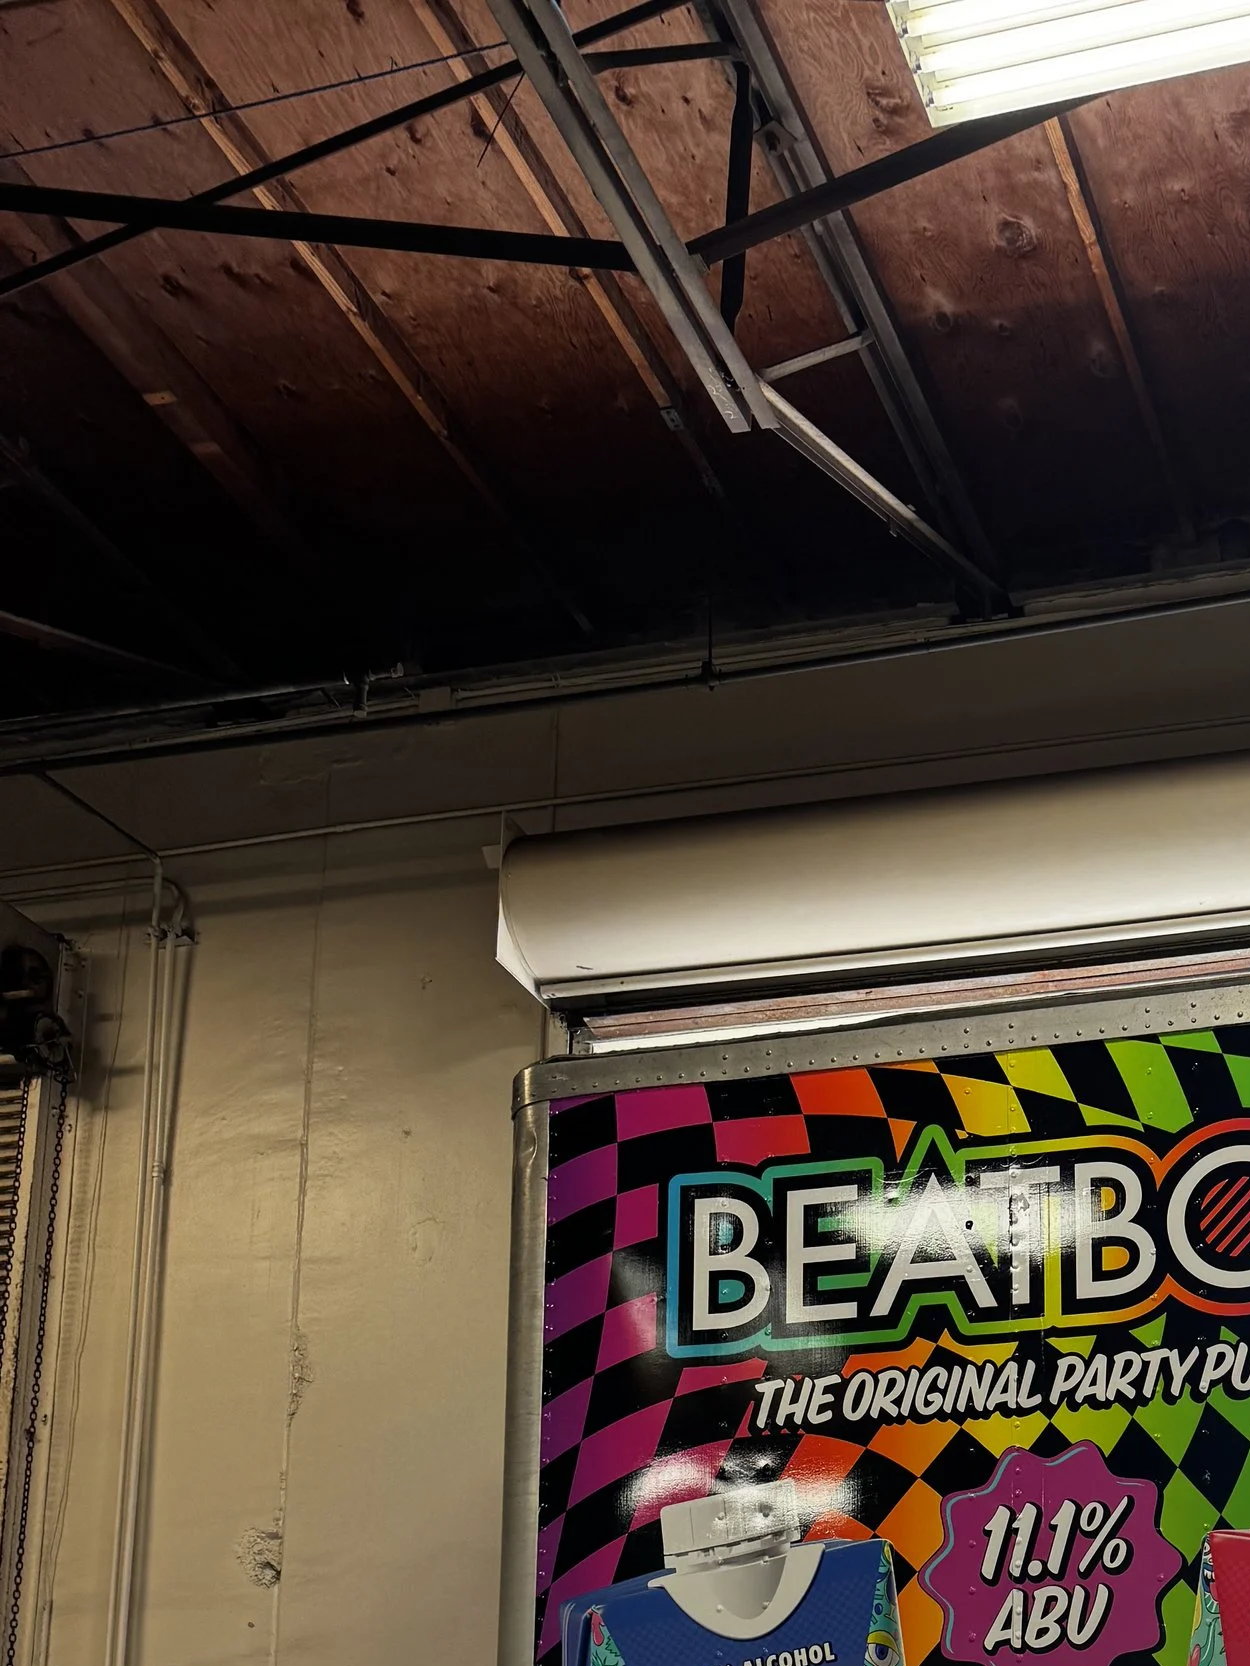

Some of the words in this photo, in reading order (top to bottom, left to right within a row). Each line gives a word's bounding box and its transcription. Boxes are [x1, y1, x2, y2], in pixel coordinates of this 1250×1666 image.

[755, 1375, 841, 1429] THE
[843, 1358, 1042, 1421] ORIGINAL
[1049, 1346, 1199, 1405] PARTY
[981, 1496, 1129, 1581] 11.1%
